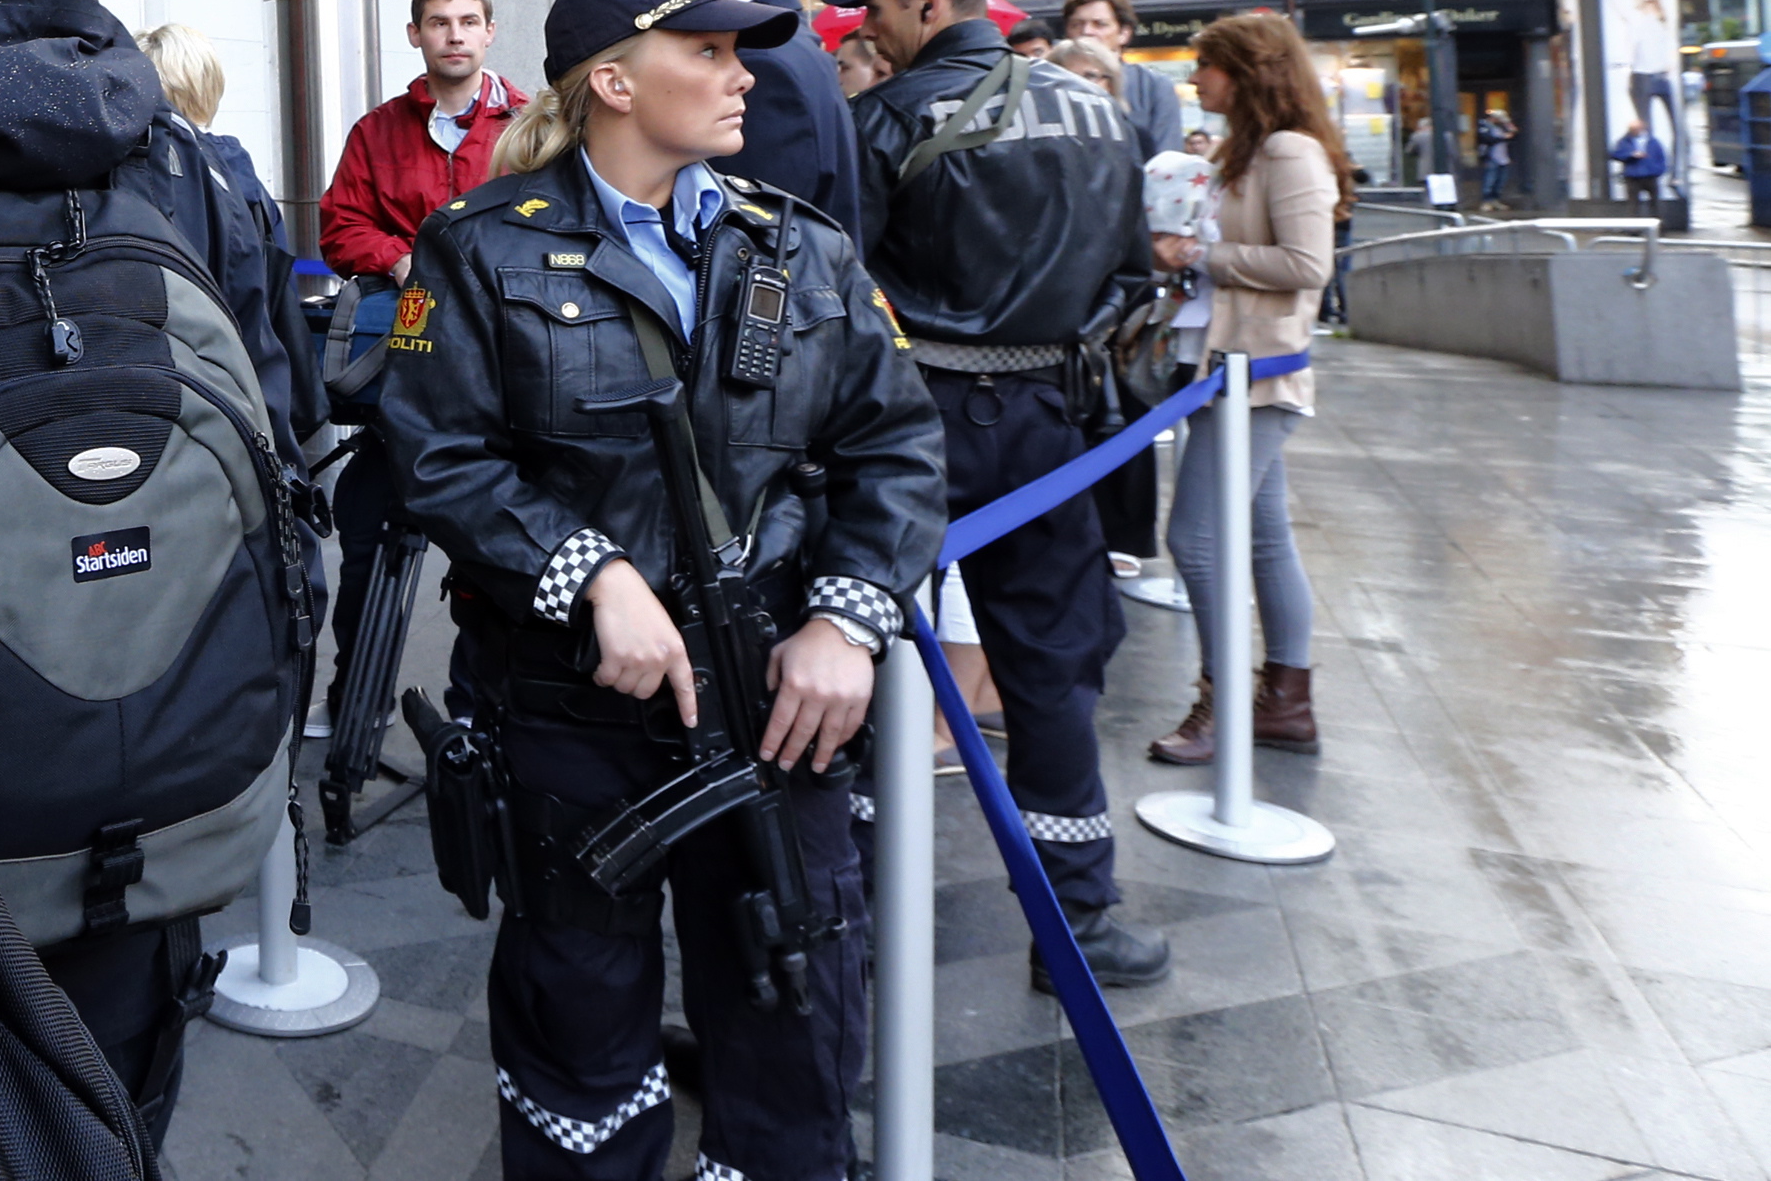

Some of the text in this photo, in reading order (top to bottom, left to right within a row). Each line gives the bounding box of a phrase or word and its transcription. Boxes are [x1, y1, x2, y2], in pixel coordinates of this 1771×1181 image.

[550, 253, 586, 266] N868
[388, 336, 433, 353] OLITI
[88, 540, 108, 558] ABC
[75, 545, 148, 574] Startsiden
